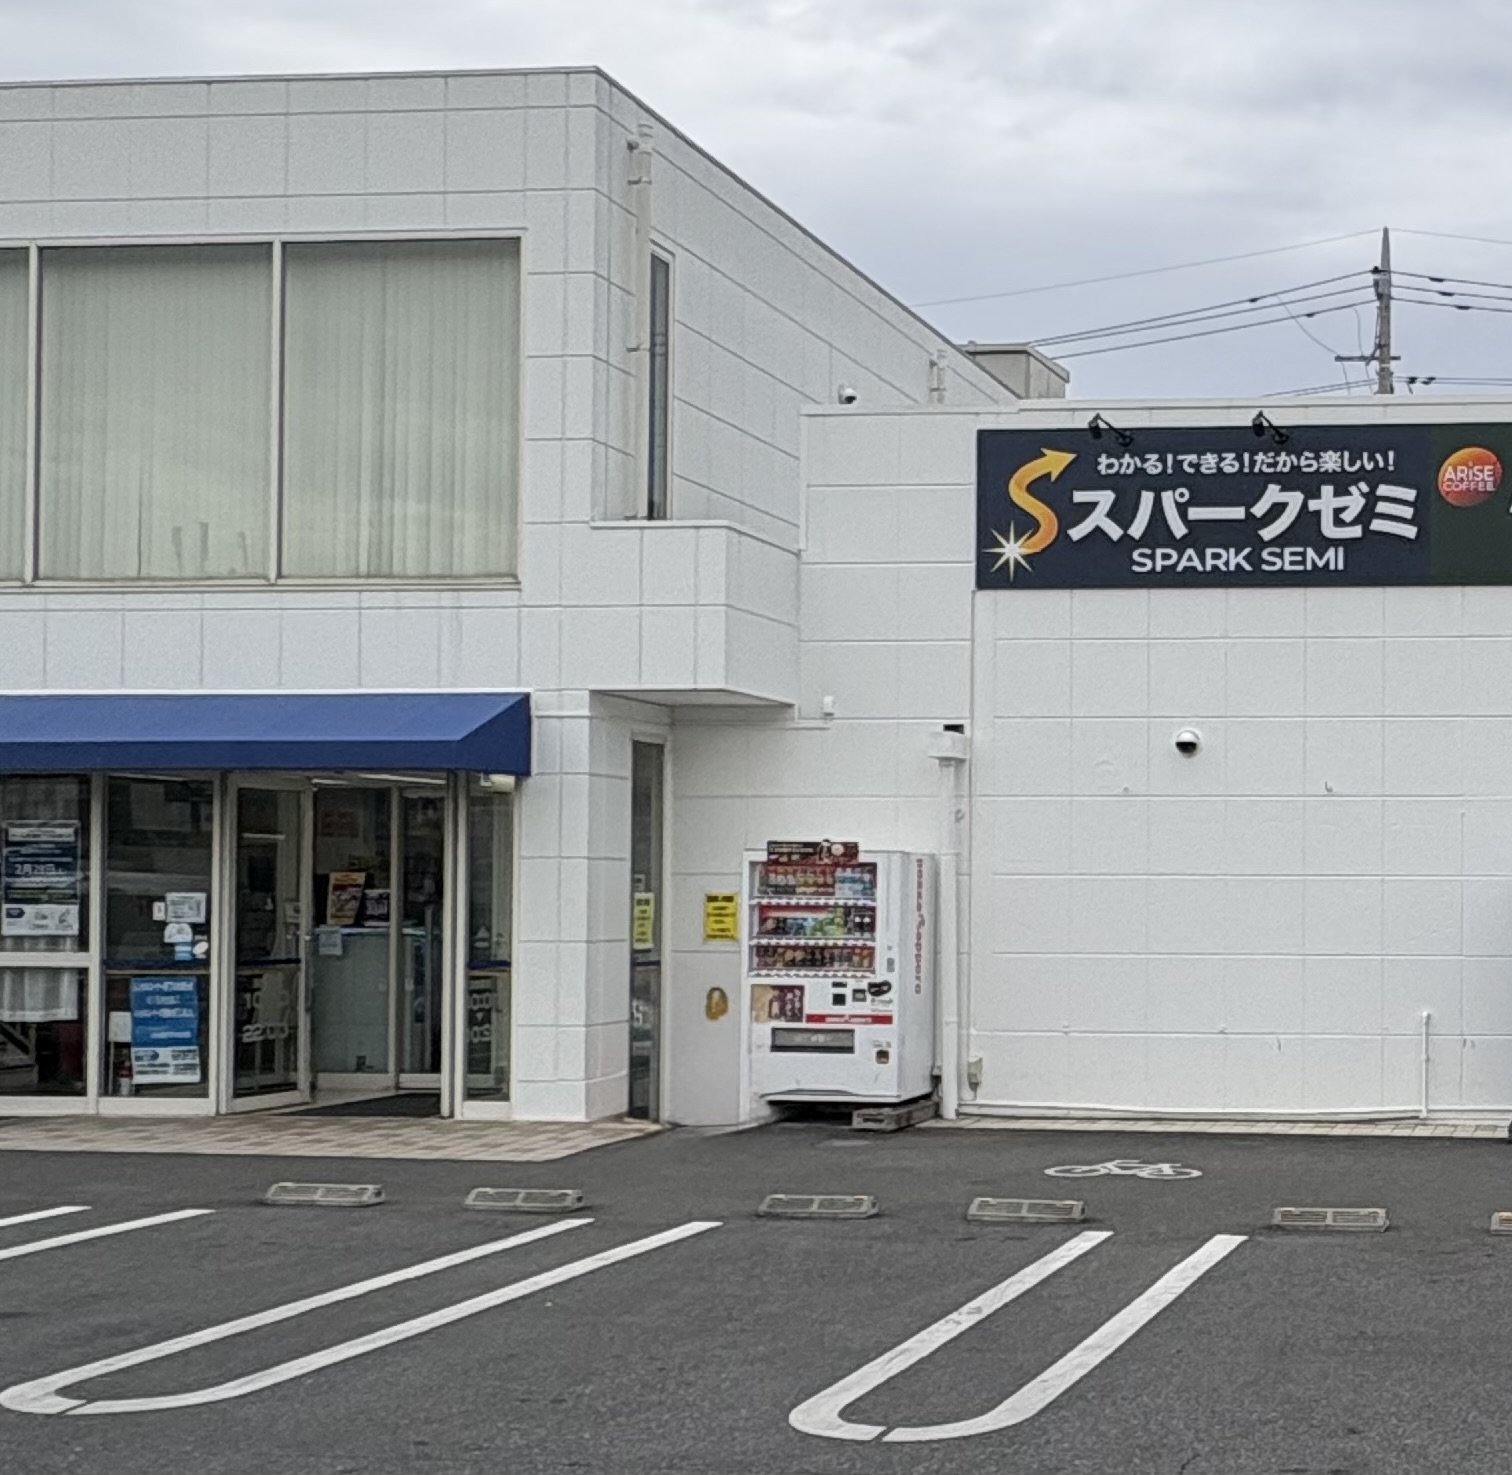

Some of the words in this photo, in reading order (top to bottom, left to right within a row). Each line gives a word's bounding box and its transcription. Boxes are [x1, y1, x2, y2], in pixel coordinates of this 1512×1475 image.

[1066, 481, 1419, 542] スパークゼミ
[1131, 547, 1254, 573] SPARK
[1261, 547, 1345, 572] SEMI
